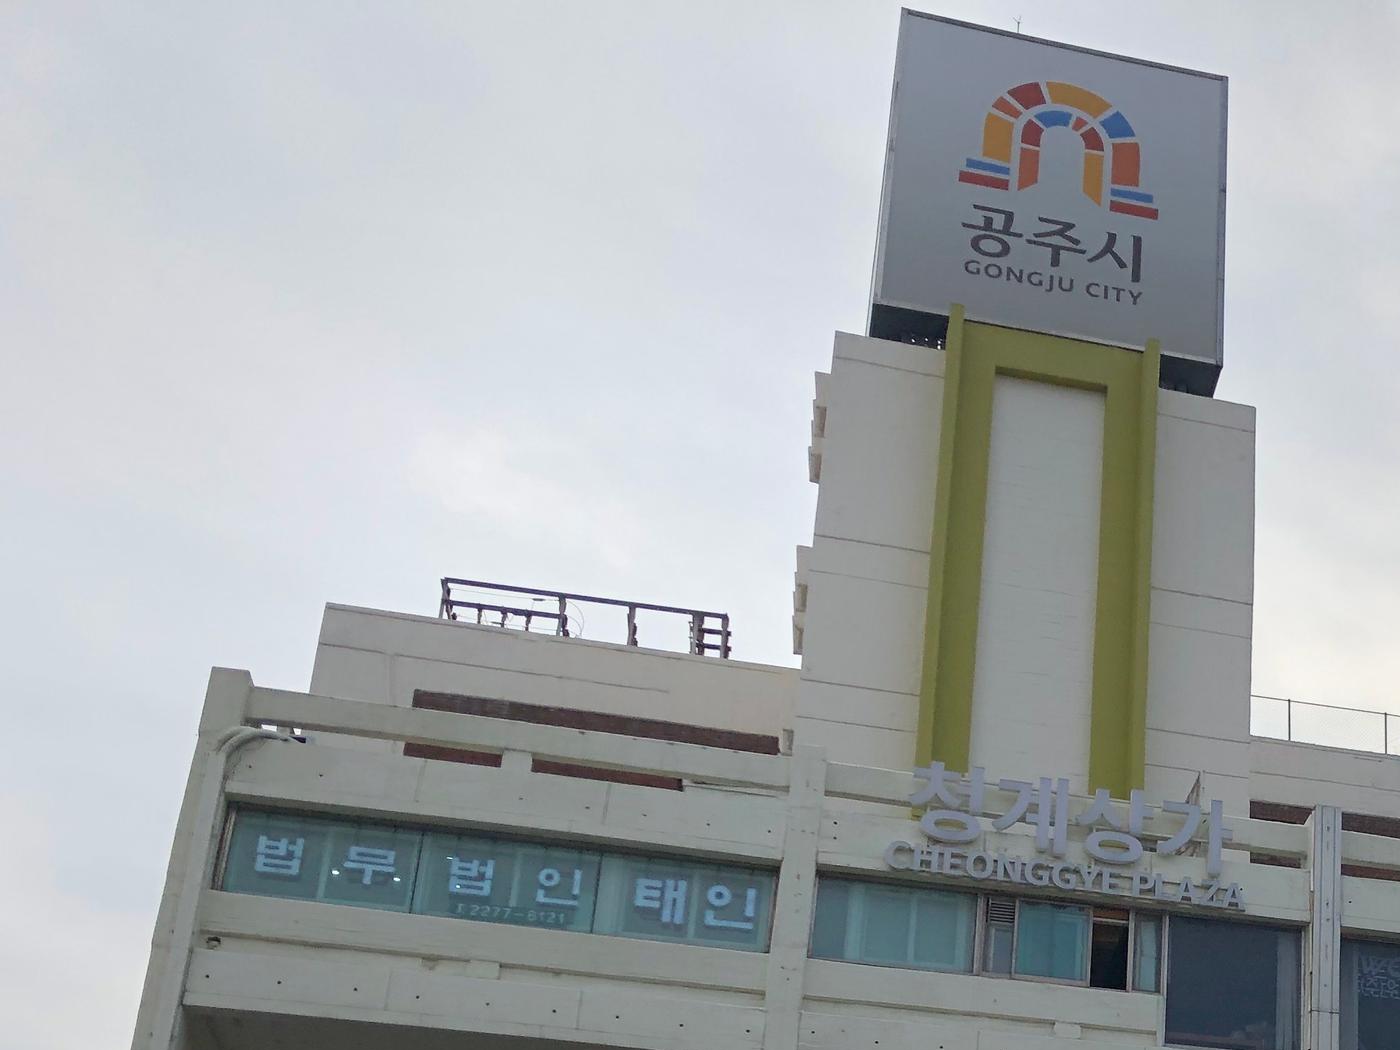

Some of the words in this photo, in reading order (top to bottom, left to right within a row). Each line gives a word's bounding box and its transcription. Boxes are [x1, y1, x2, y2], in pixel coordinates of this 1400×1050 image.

[961, 204, 1142, 283] 공주시
[964, 260, 1075, 292] GONGJU
[1086, 282, 1143, 305] CITY
[908, 761, 1232, 878] 청계상가
[254, 835, 581, 906] 법무법인
[634, 877, 758, 930] 태인
[884, 840, 1122, 894] CHEONGGYE
[1131, 870, 1246, 911] PLAZA
